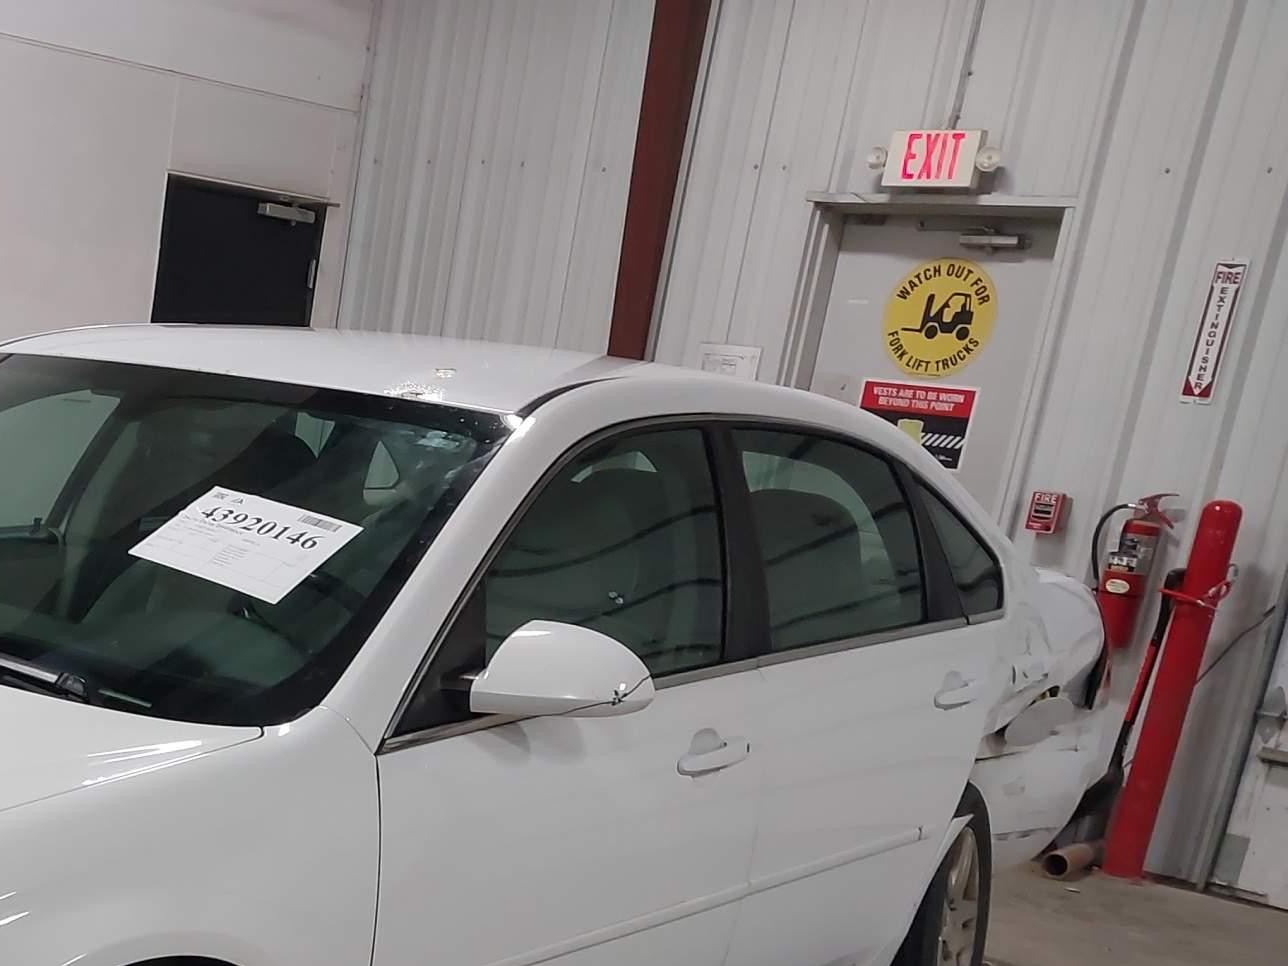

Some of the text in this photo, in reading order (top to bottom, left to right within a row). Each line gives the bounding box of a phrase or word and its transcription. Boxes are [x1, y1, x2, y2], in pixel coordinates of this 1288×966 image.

[900, 132, 967, 181] EXIT
[896, 263, 991, 306] WATCH OUT FOR
[1214, 271, 1242, 285] FIRE
[887, 330, 980, 373] FORK LIFT TRUCKS
[1193, 286, 1229, 390] EXTINGUISHER
[873, 386, 966, 403] VESTS ARE TO BE WORN
[878, 397, 954, 411] BEYOND THIS POINT
[1033, 492, 1058, 504] FIRE
[201, 506, 325, 550] 43920146
